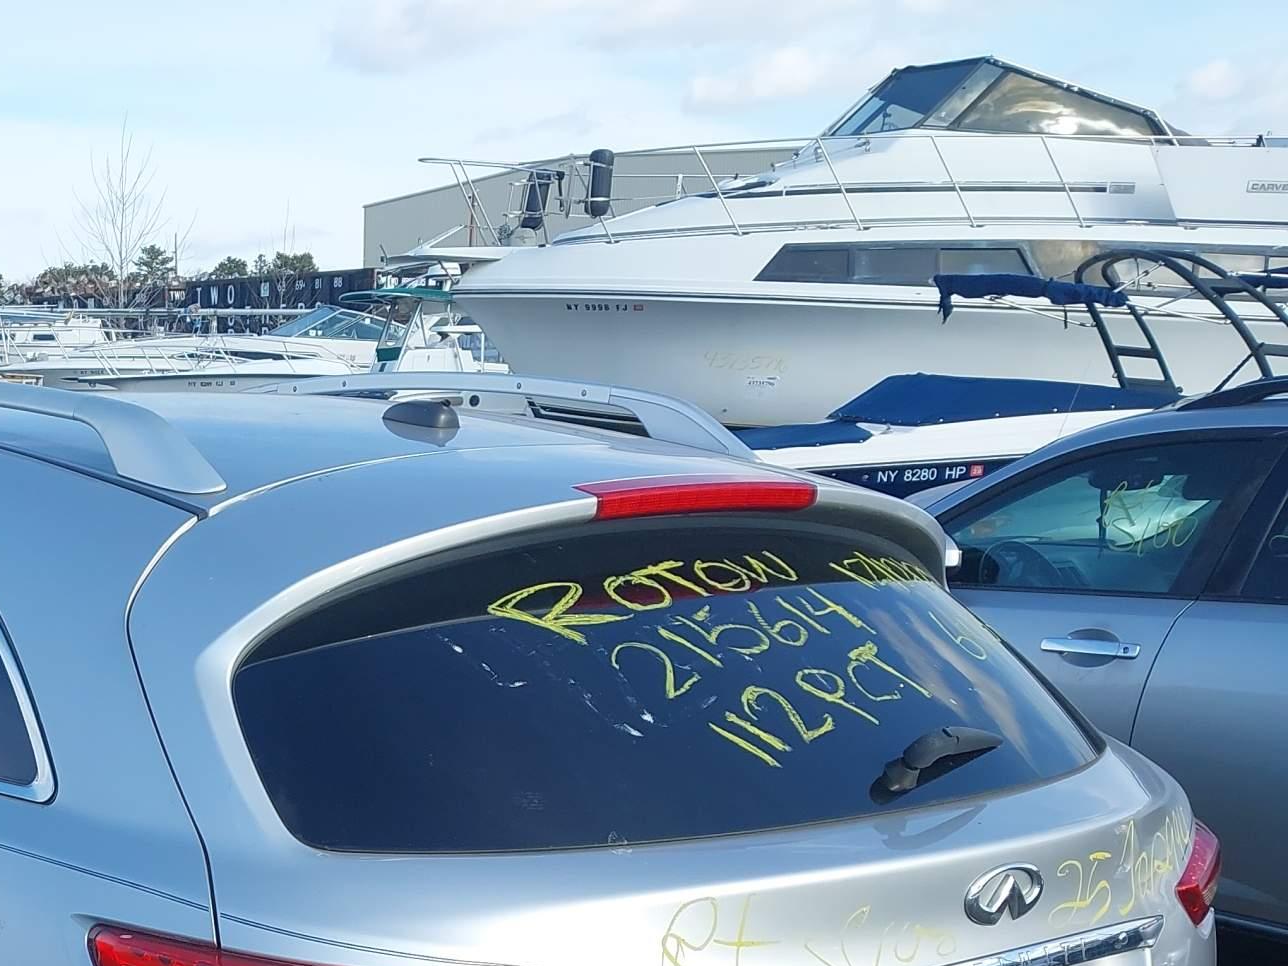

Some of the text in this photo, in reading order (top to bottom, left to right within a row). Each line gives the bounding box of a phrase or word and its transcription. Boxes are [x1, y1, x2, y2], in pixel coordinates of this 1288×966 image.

[169, 290, 186, 301] TWO
[877, 470, 898, 482] NY
[904, 468, 938, 481] 8280
[945, 466, 967, 479] HP
